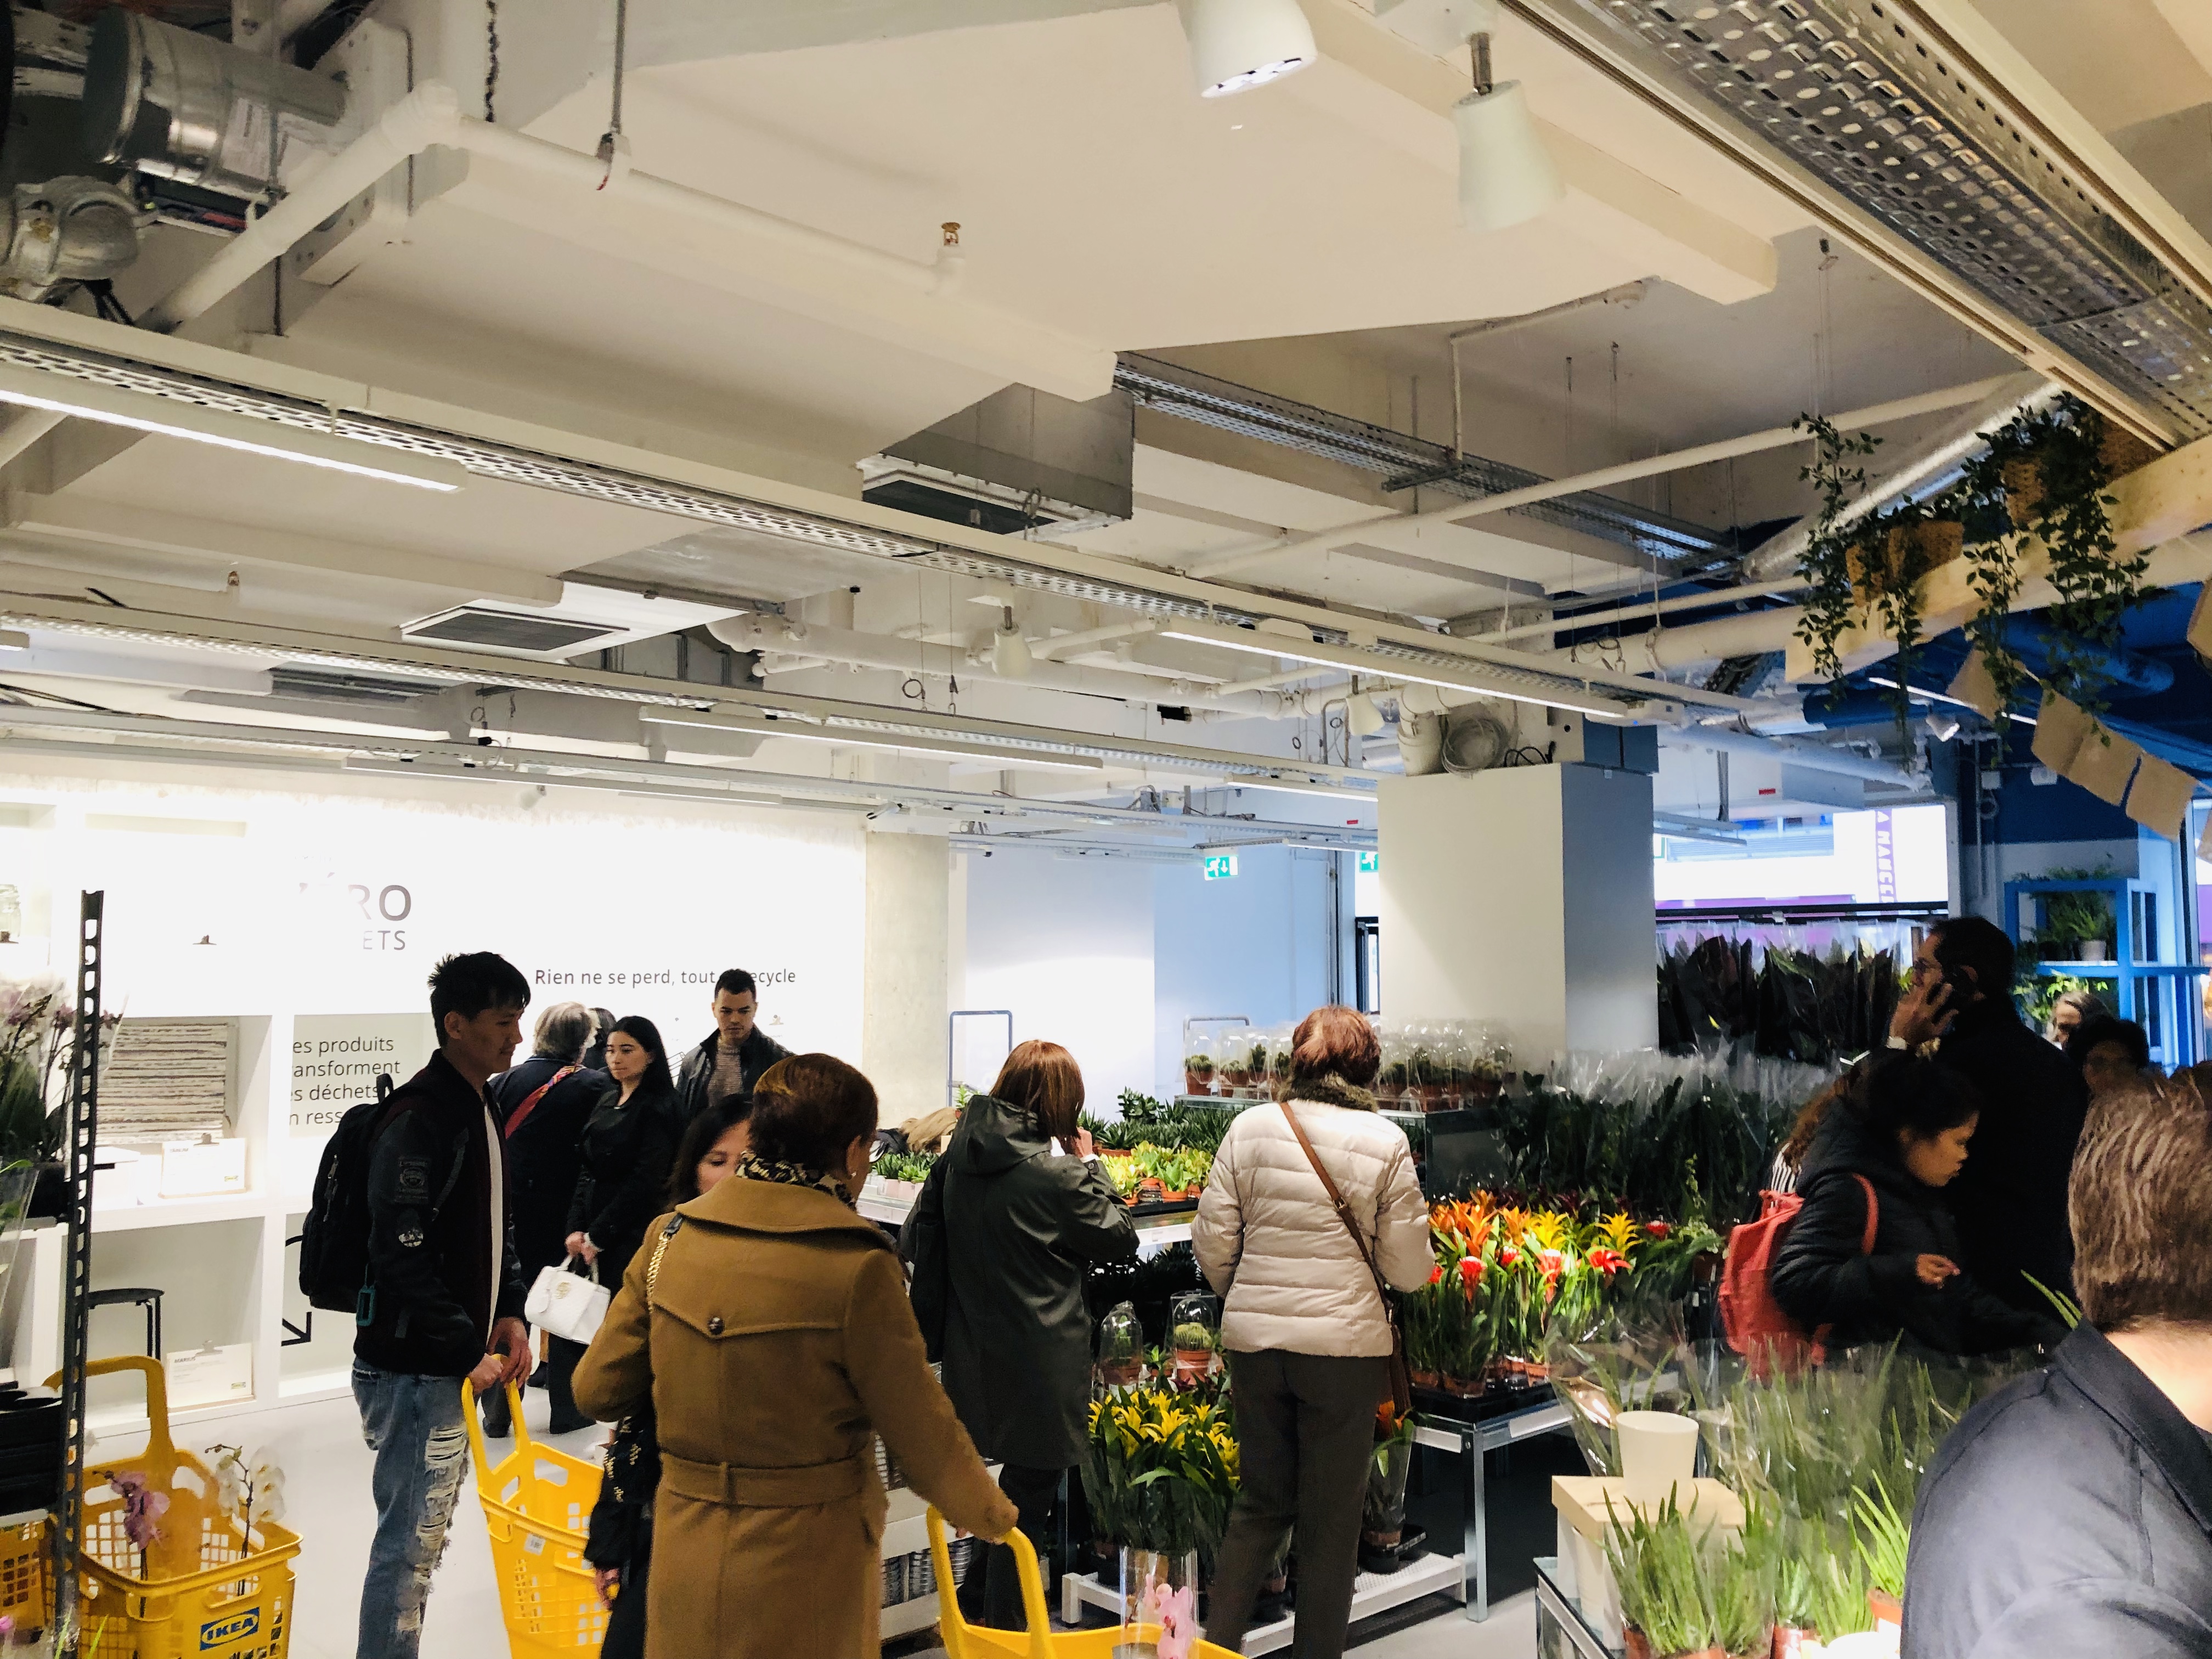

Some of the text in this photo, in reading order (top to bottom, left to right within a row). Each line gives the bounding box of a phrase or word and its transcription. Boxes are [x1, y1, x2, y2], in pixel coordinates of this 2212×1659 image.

[535, 968, 795, 989] Rien ne se perd, tout ecycle
[319, 1036, 394, 1057] produits
[292, 1060, 400, 1077] ansforment
[291, 1083, 378, 1102] s déchets
[306, 1110, 342, 1125] ress
[207, 1617, 253, 1641] IKEA
